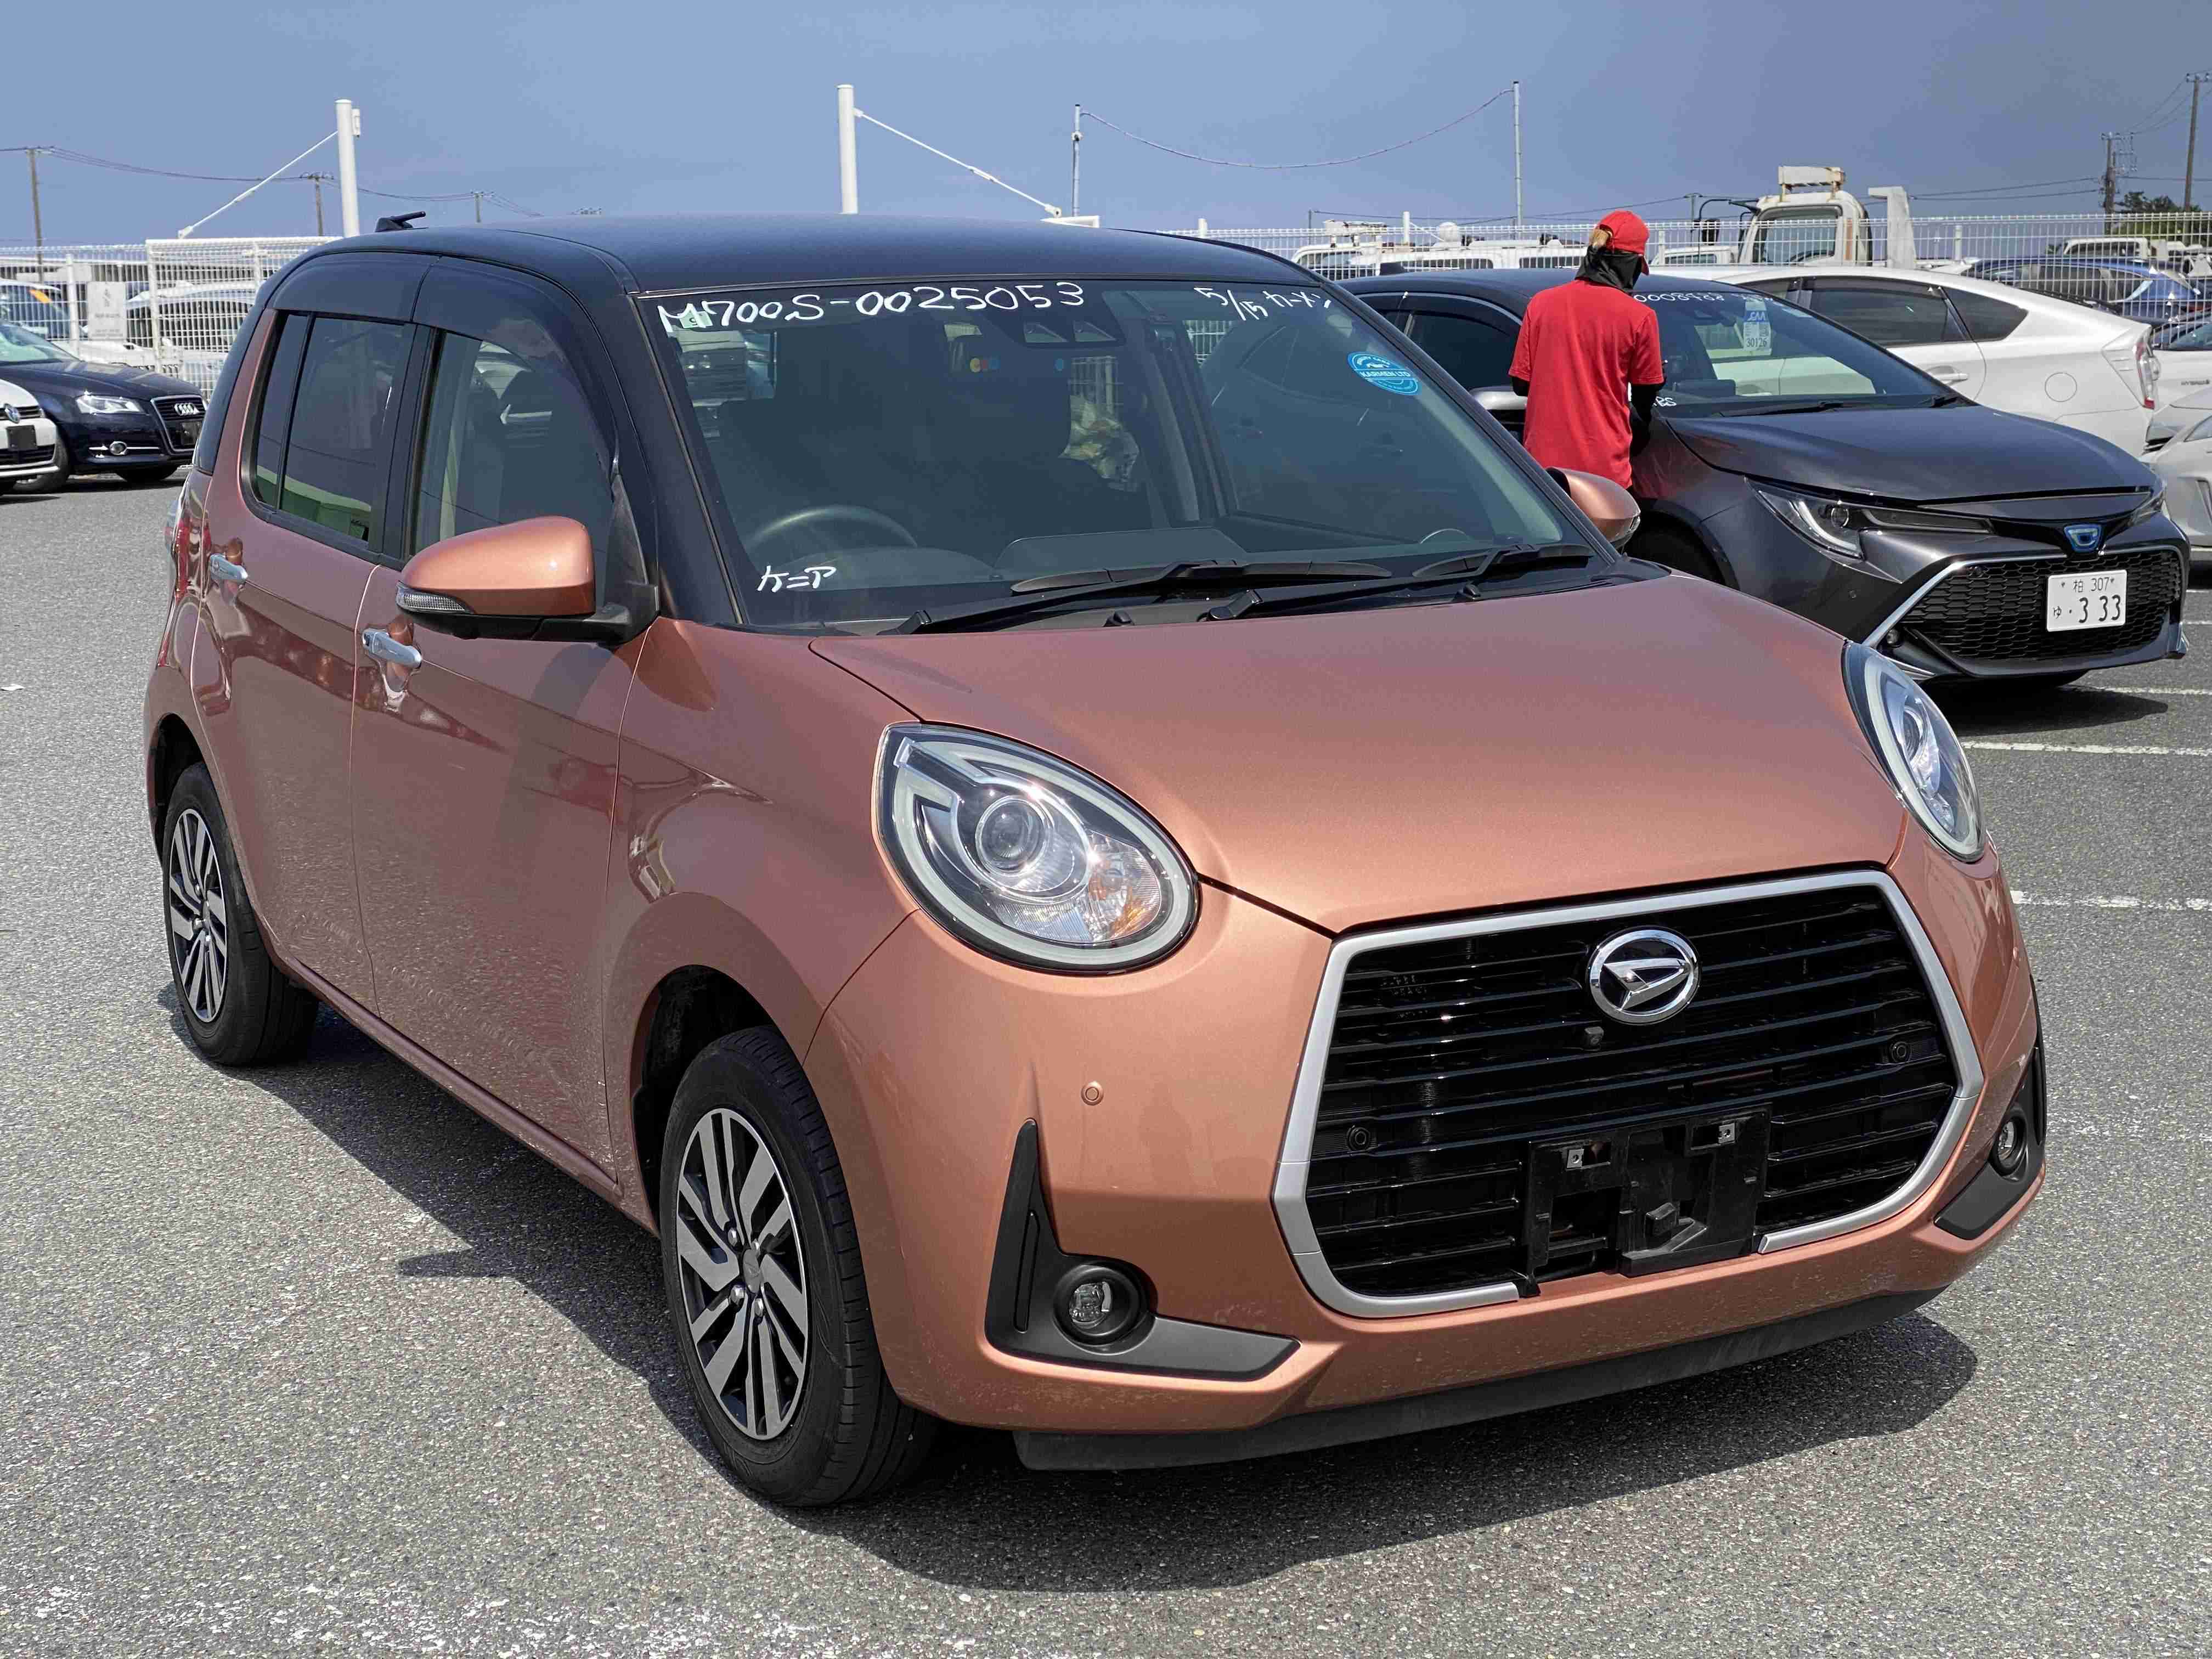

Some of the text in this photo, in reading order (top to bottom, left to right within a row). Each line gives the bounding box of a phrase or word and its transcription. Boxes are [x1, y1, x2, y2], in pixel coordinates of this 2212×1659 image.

[1746, 338, 1768, 348] 30126
[2073, 577, 2109, 593] 柏 307
[2053, 606, 2062, 619] ゆ
